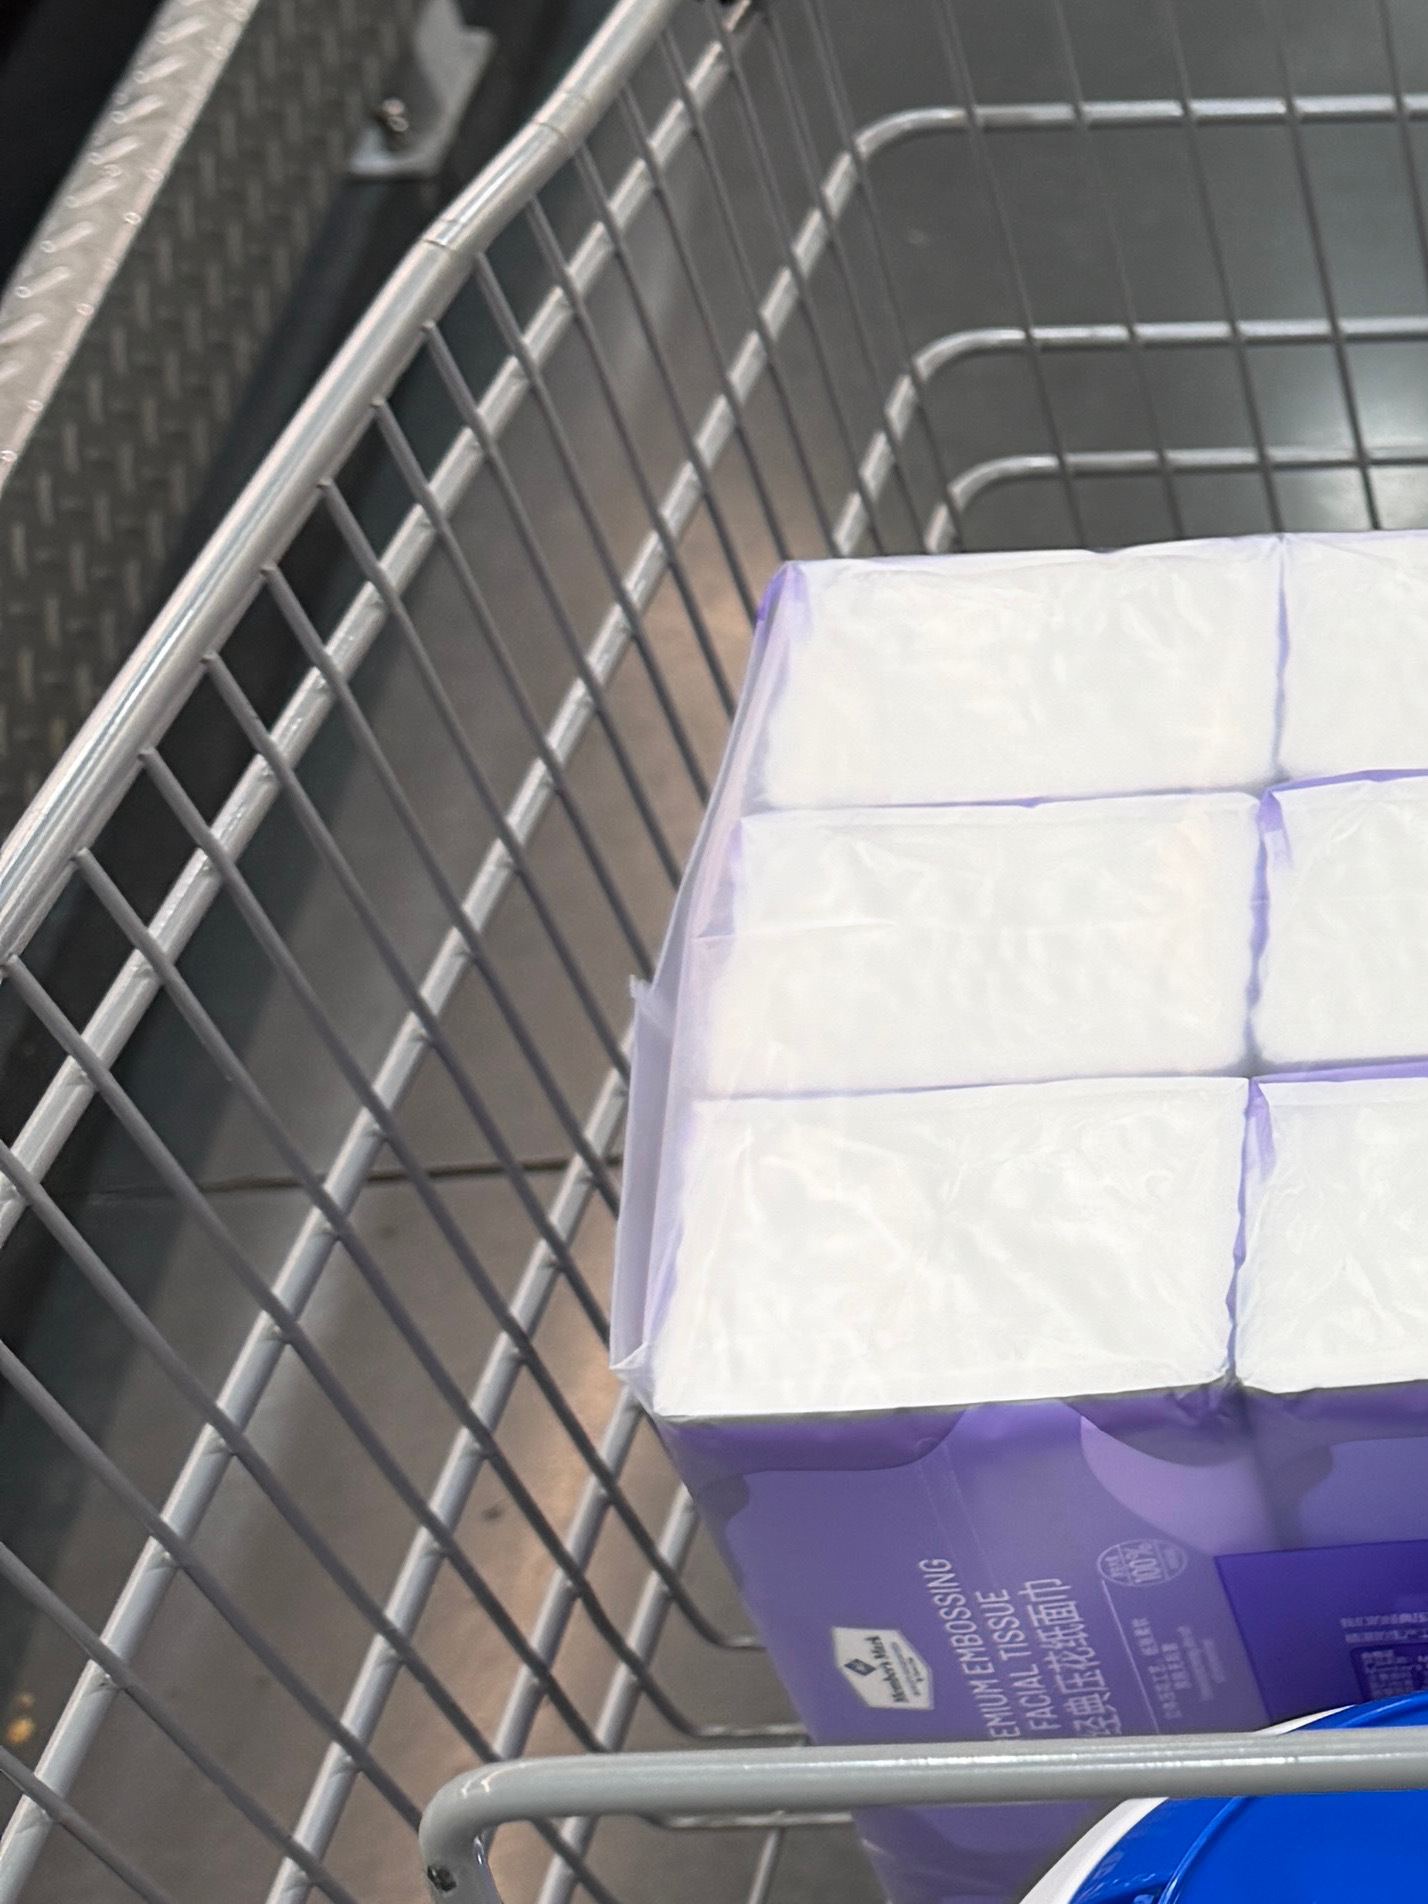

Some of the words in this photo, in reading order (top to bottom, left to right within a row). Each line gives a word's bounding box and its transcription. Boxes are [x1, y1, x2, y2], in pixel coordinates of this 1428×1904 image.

[975, 1589, 1034, 1659] TISSUE
[970, 1678, 1021, 1739] EMIUM
[1009, 1663, 1061, 1732] FACIAL
